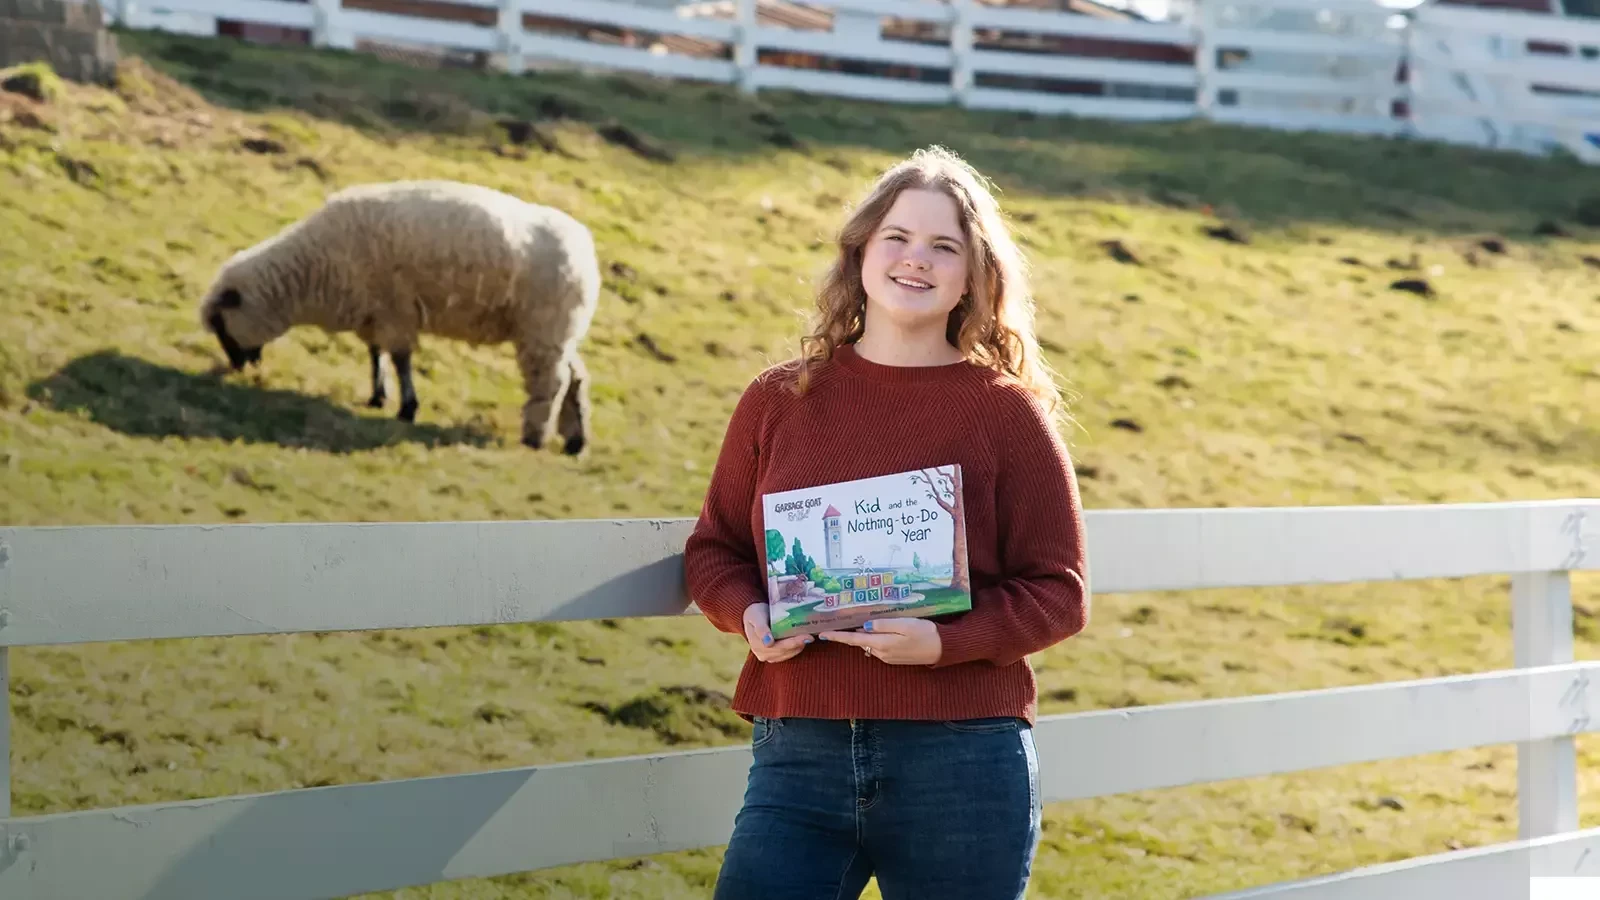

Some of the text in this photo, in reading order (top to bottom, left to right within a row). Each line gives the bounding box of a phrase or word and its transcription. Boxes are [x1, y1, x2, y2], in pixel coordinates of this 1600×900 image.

[774, 497, 822, 513] GARBAGE GOAT
[854, 497, 918, 515] Kid and the
[847, 508, 938, 535] Nothing-to-Do
[901, 527, 932, 543] Year
